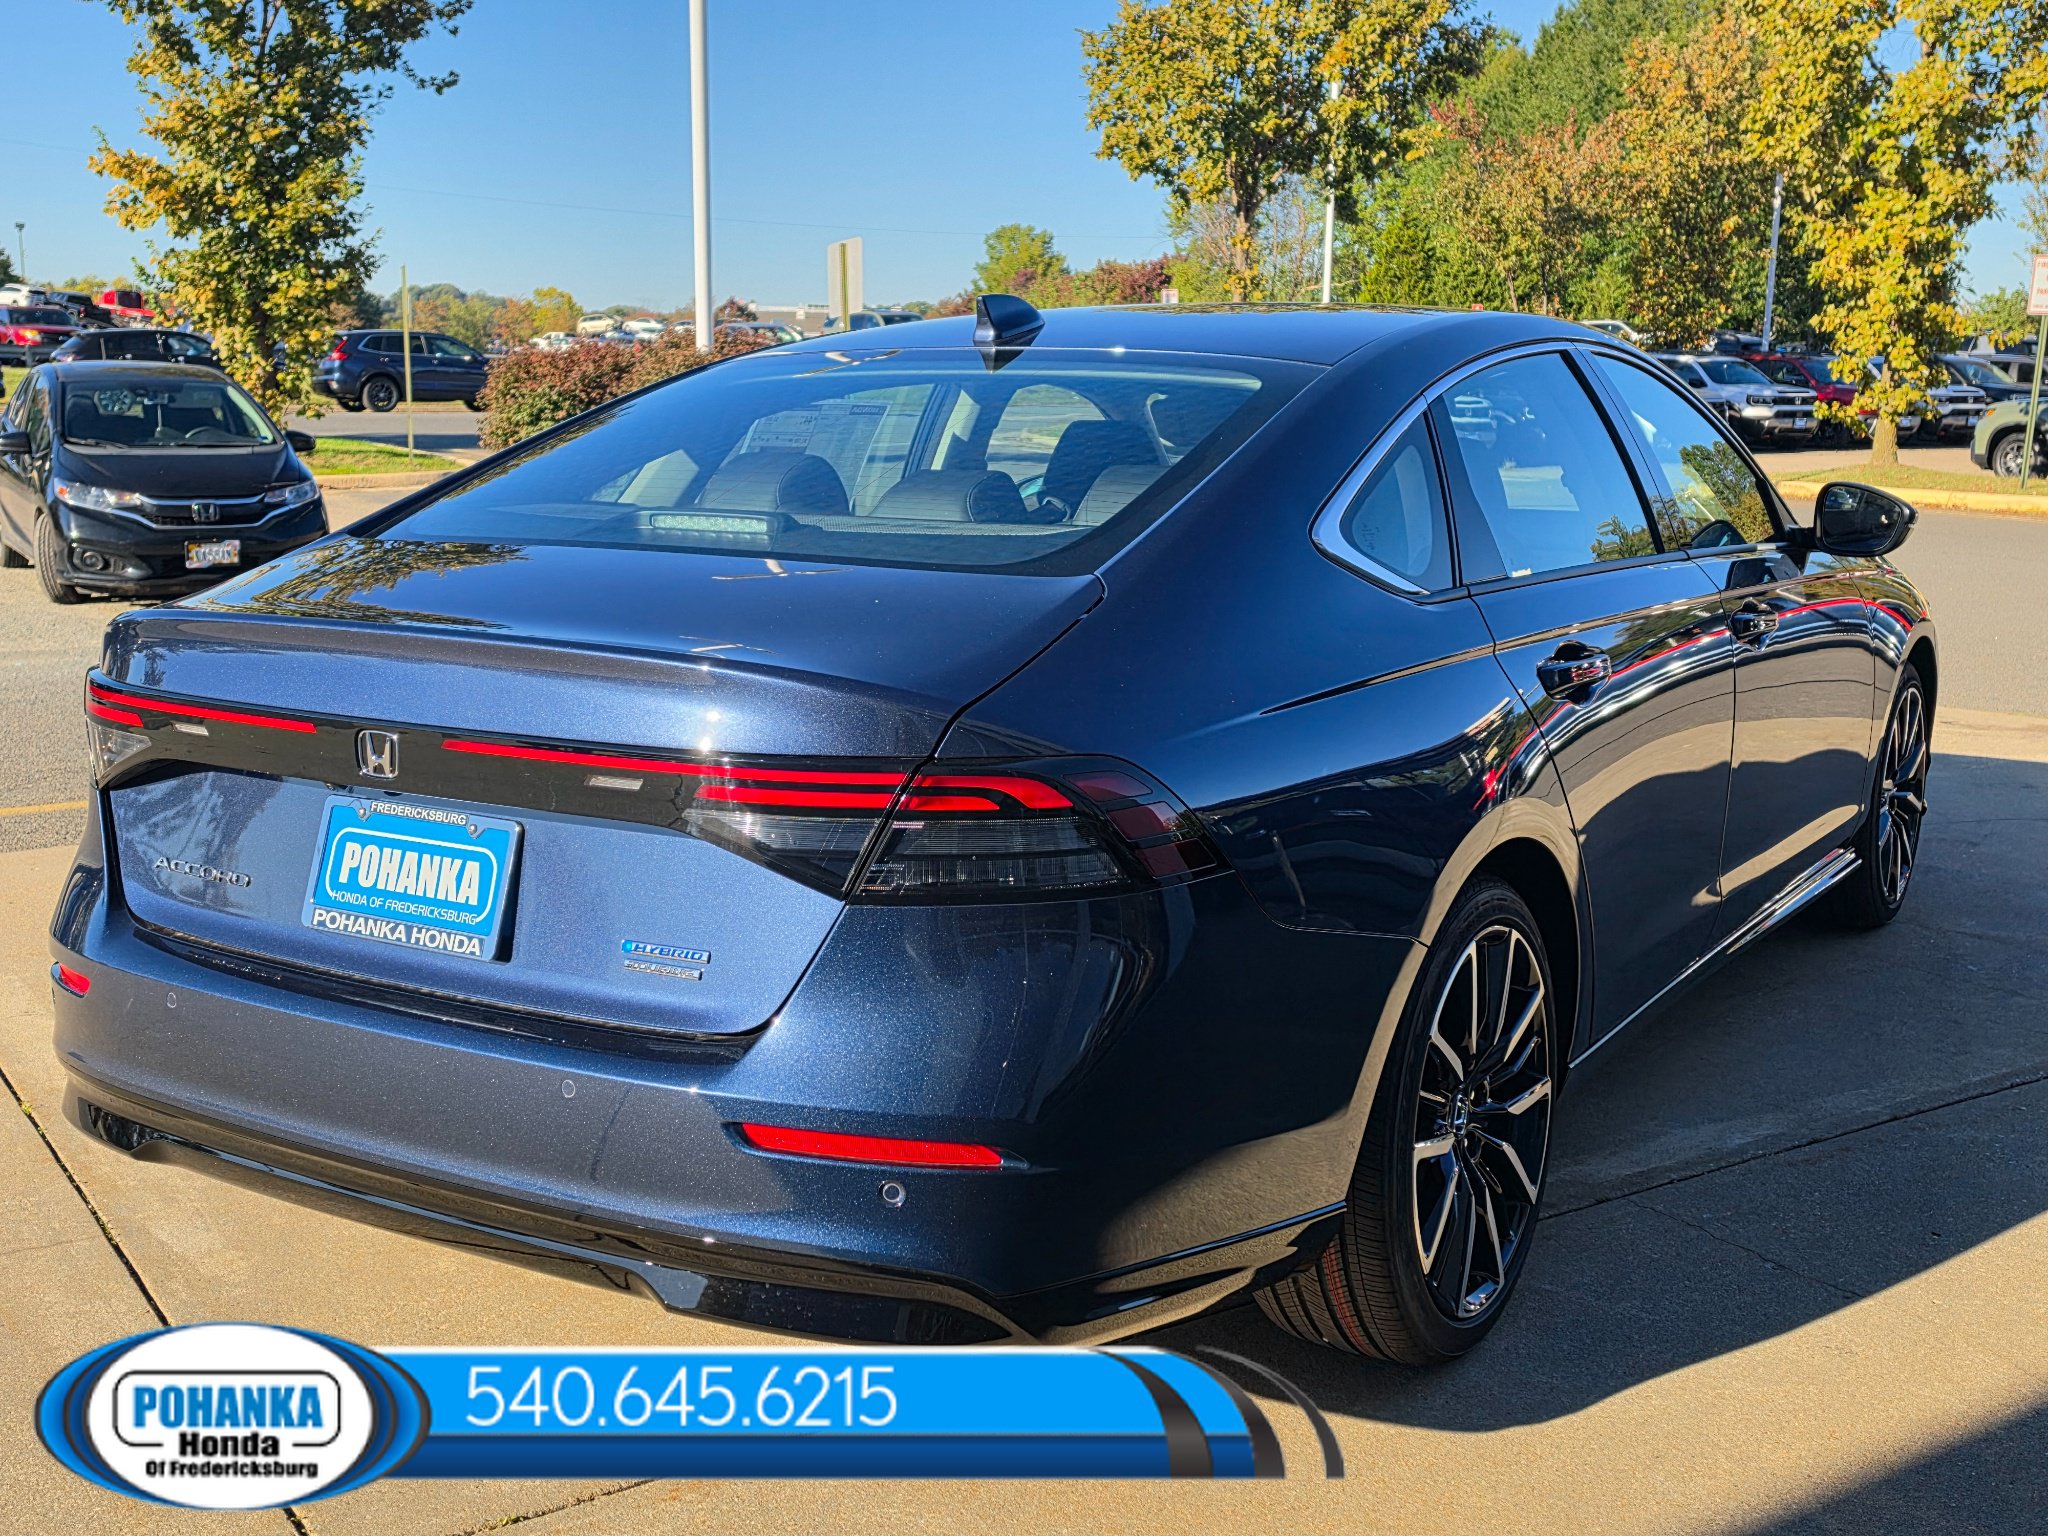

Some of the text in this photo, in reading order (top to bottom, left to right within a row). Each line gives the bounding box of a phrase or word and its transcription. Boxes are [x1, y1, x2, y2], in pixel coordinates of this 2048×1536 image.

[370, 802, 467, 825] FREDERICKSBURG
[154, 857, 251, 888] ACCORD
[338, 841, 480, 905] POHANKA
[332, 890, 478, 925] HONDA OF FREDERICKSBURG
[312, 909, 481, 956] POHANKA HONDA
[634, 943, 704, 961] HYBRID
